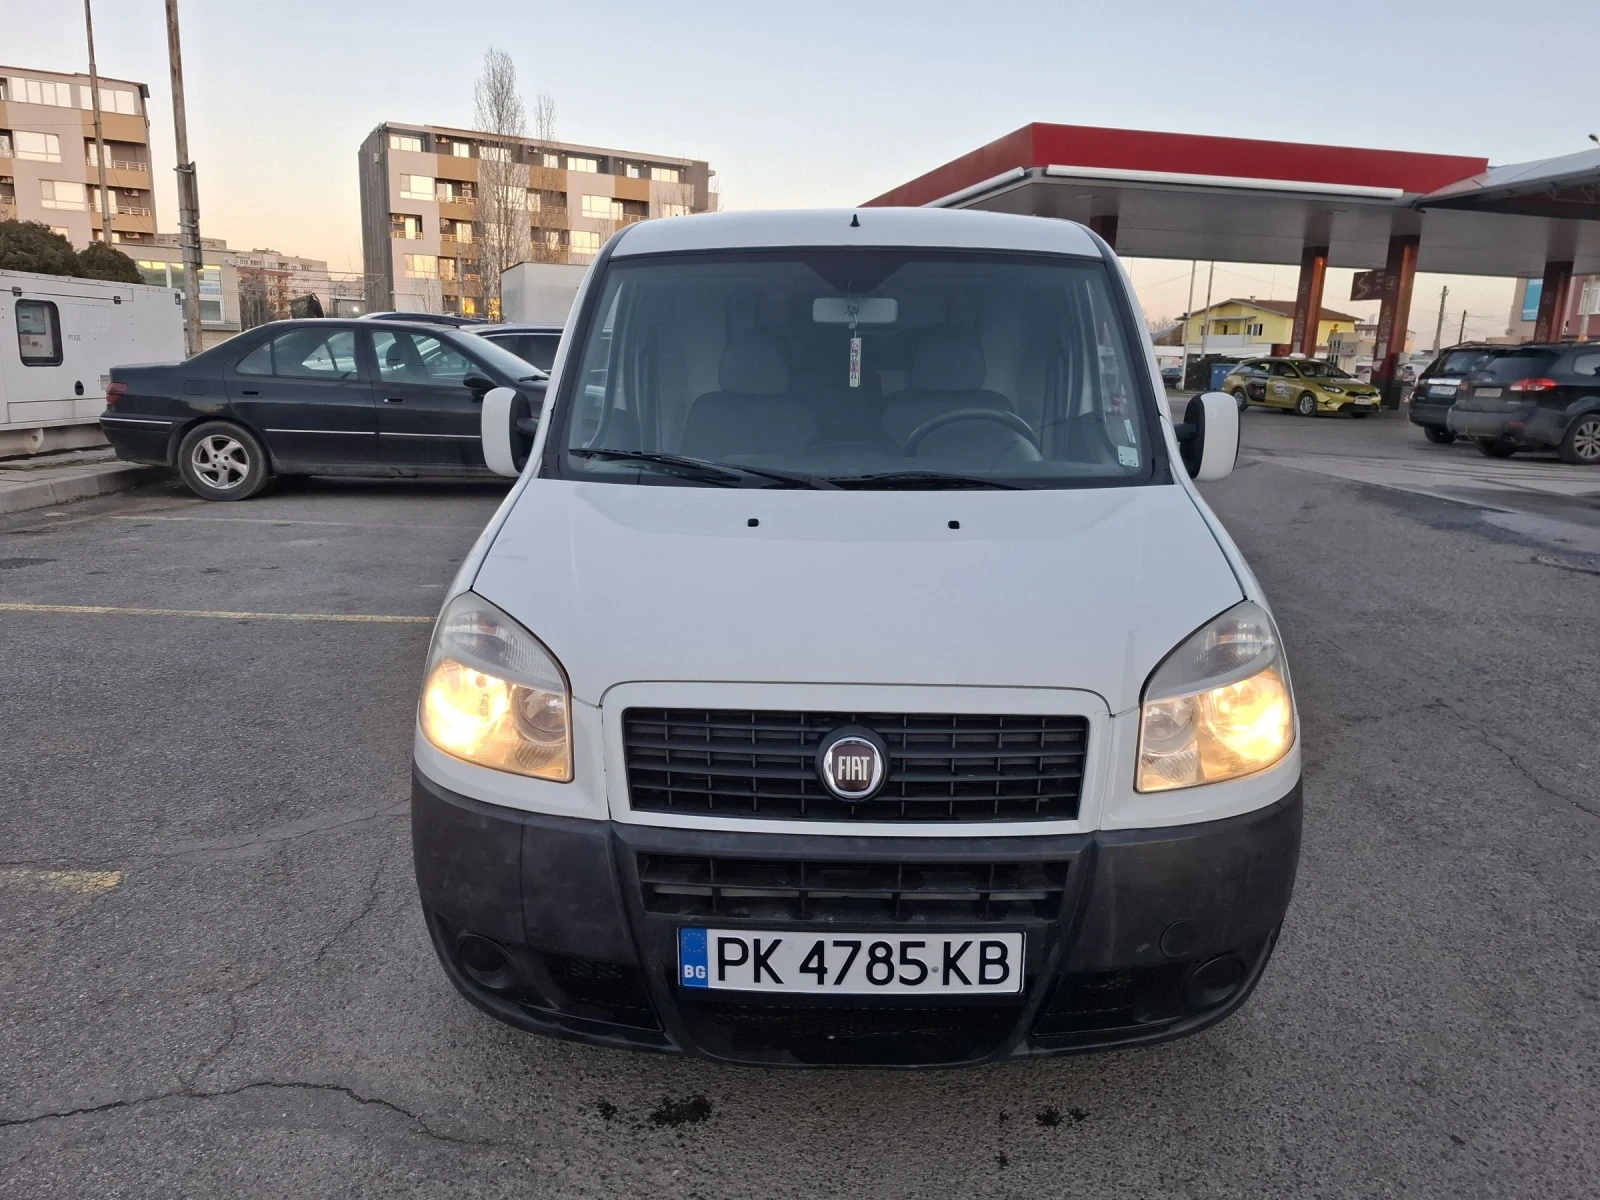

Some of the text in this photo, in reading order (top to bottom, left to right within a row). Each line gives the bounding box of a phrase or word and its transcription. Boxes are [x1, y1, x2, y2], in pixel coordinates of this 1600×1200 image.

[838, 755, 870, 781] FIAT
[684, 964, 706, 979] BG
[717, 936, 1010, 986] PK 4785 KB
